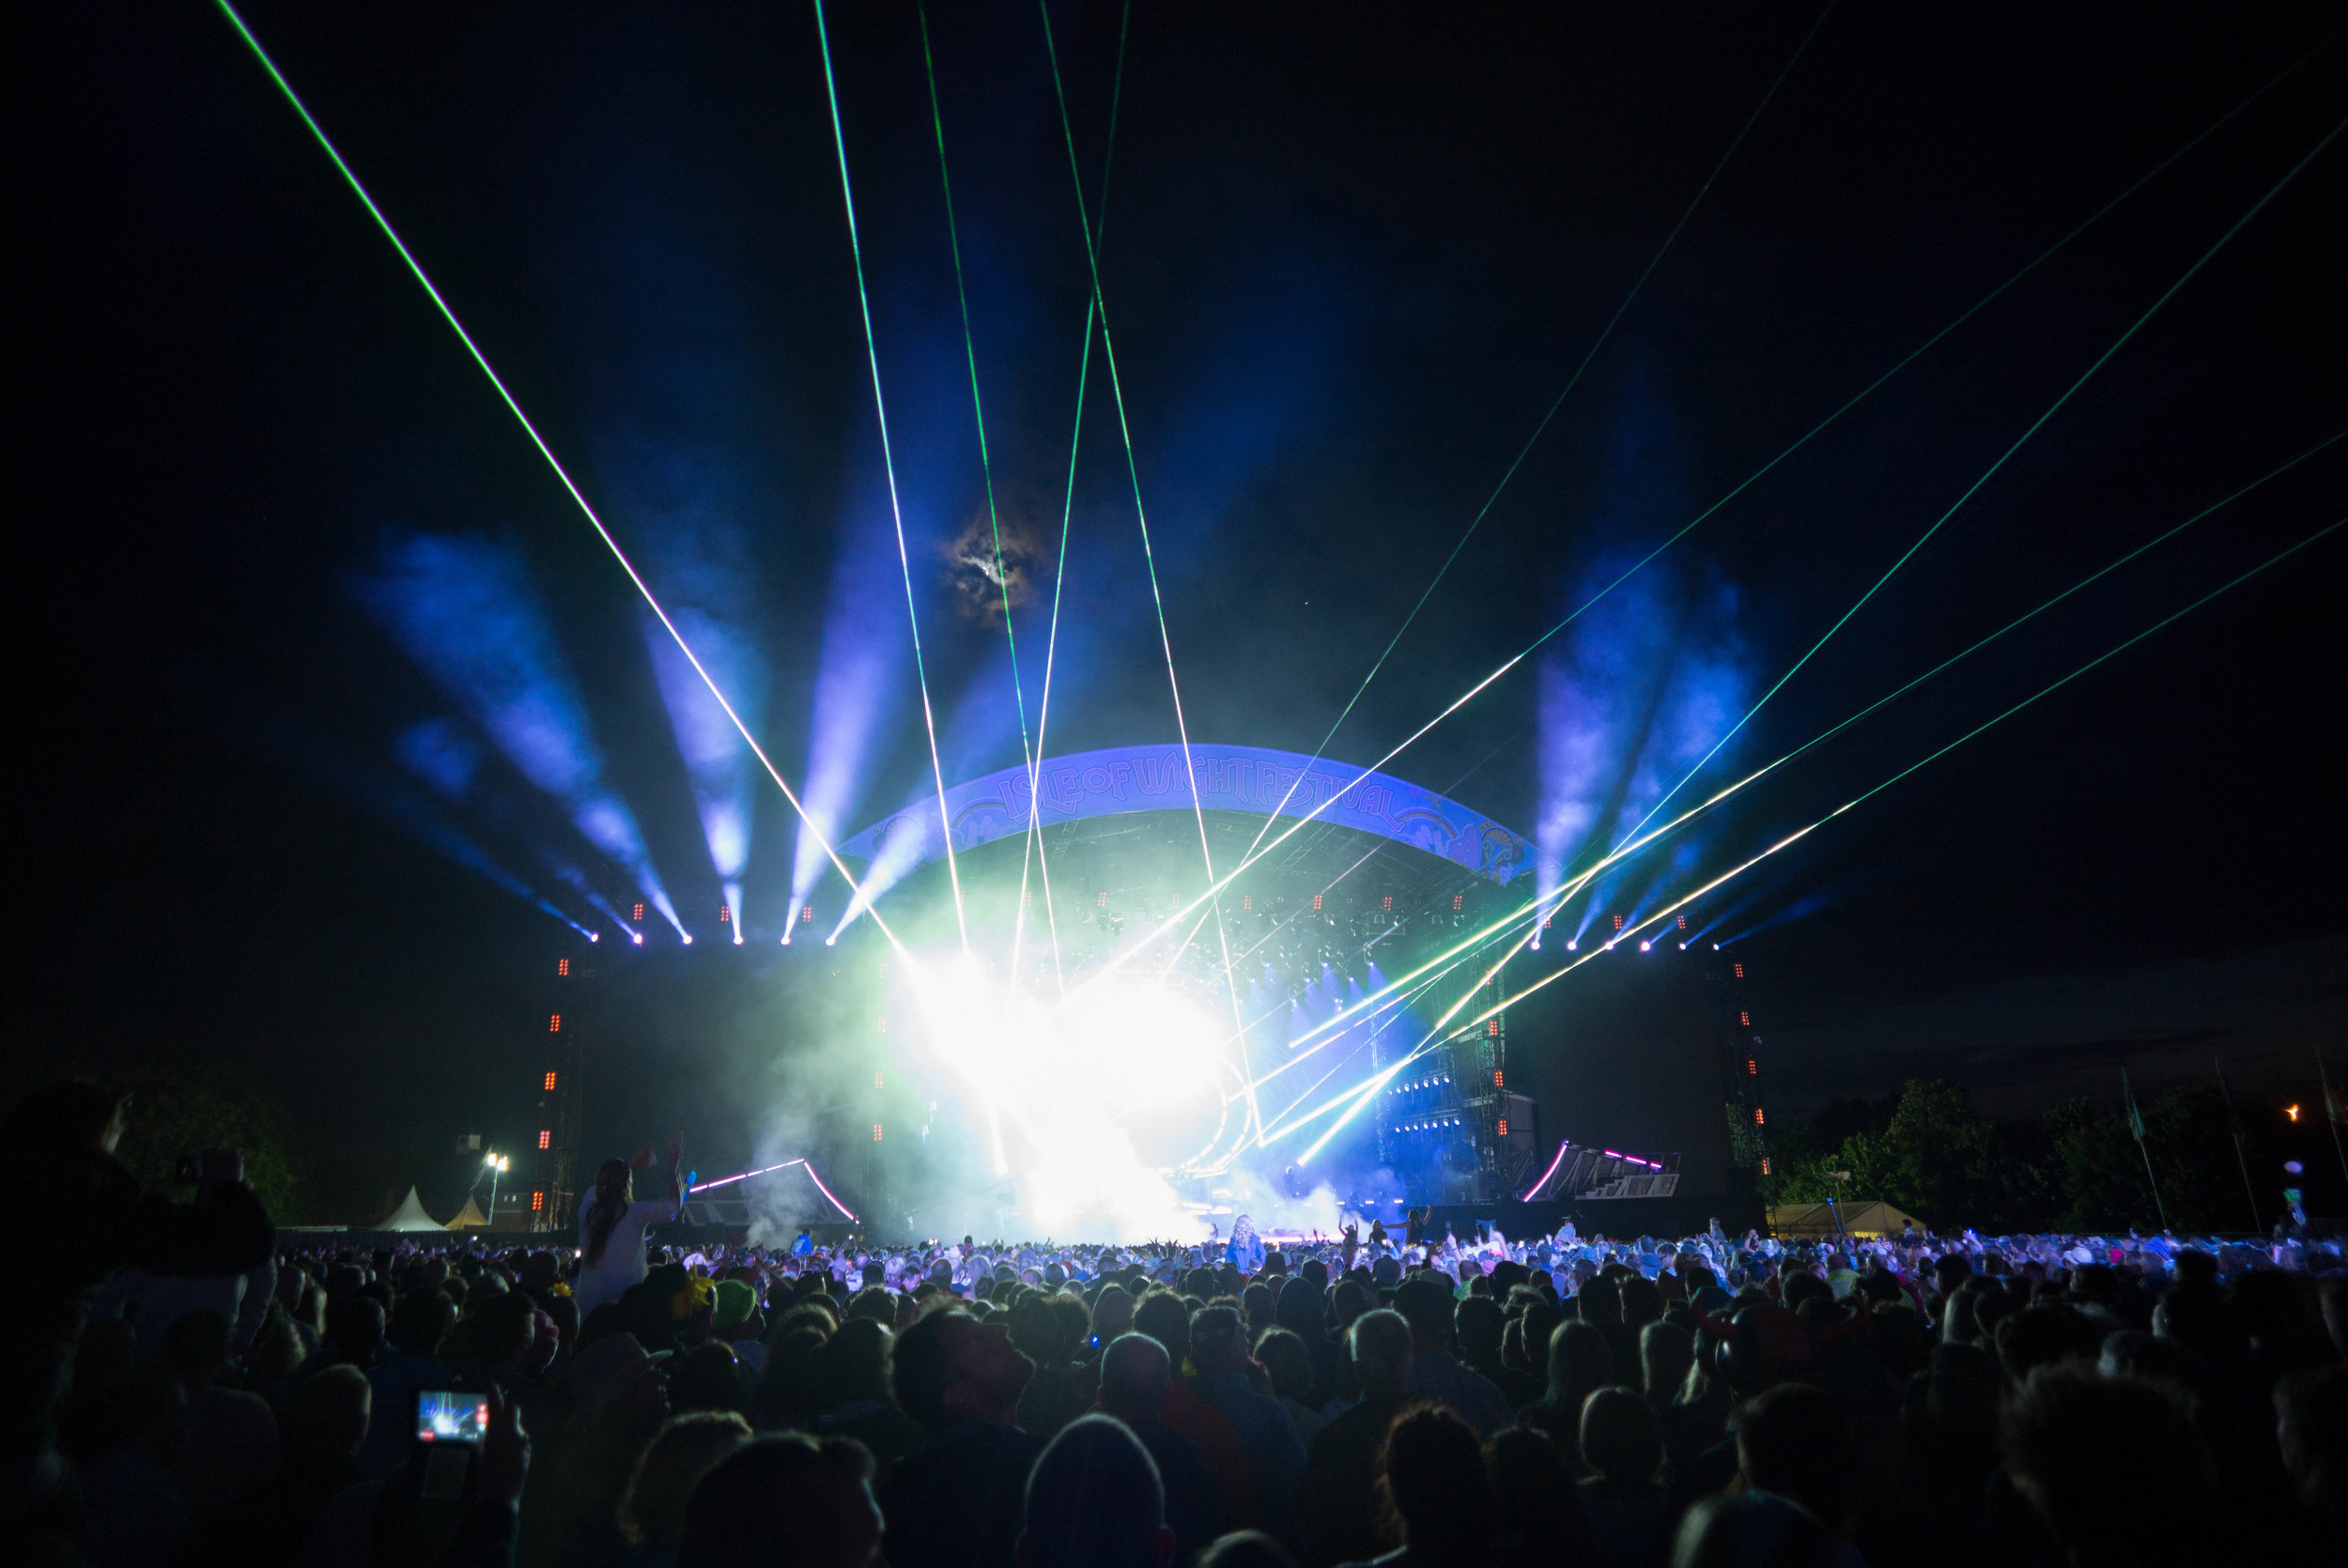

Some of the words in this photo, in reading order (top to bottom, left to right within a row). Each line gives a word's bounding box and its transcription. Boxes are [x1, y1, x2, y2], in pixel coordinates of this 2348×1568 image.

[998, 768, 1084, 824] ISLE
[1082, 761, 1130, 800] OF
[1132, 752, 1253, 803] WIGHT
[1256, 761, 1405, 833] FESTIVAL
